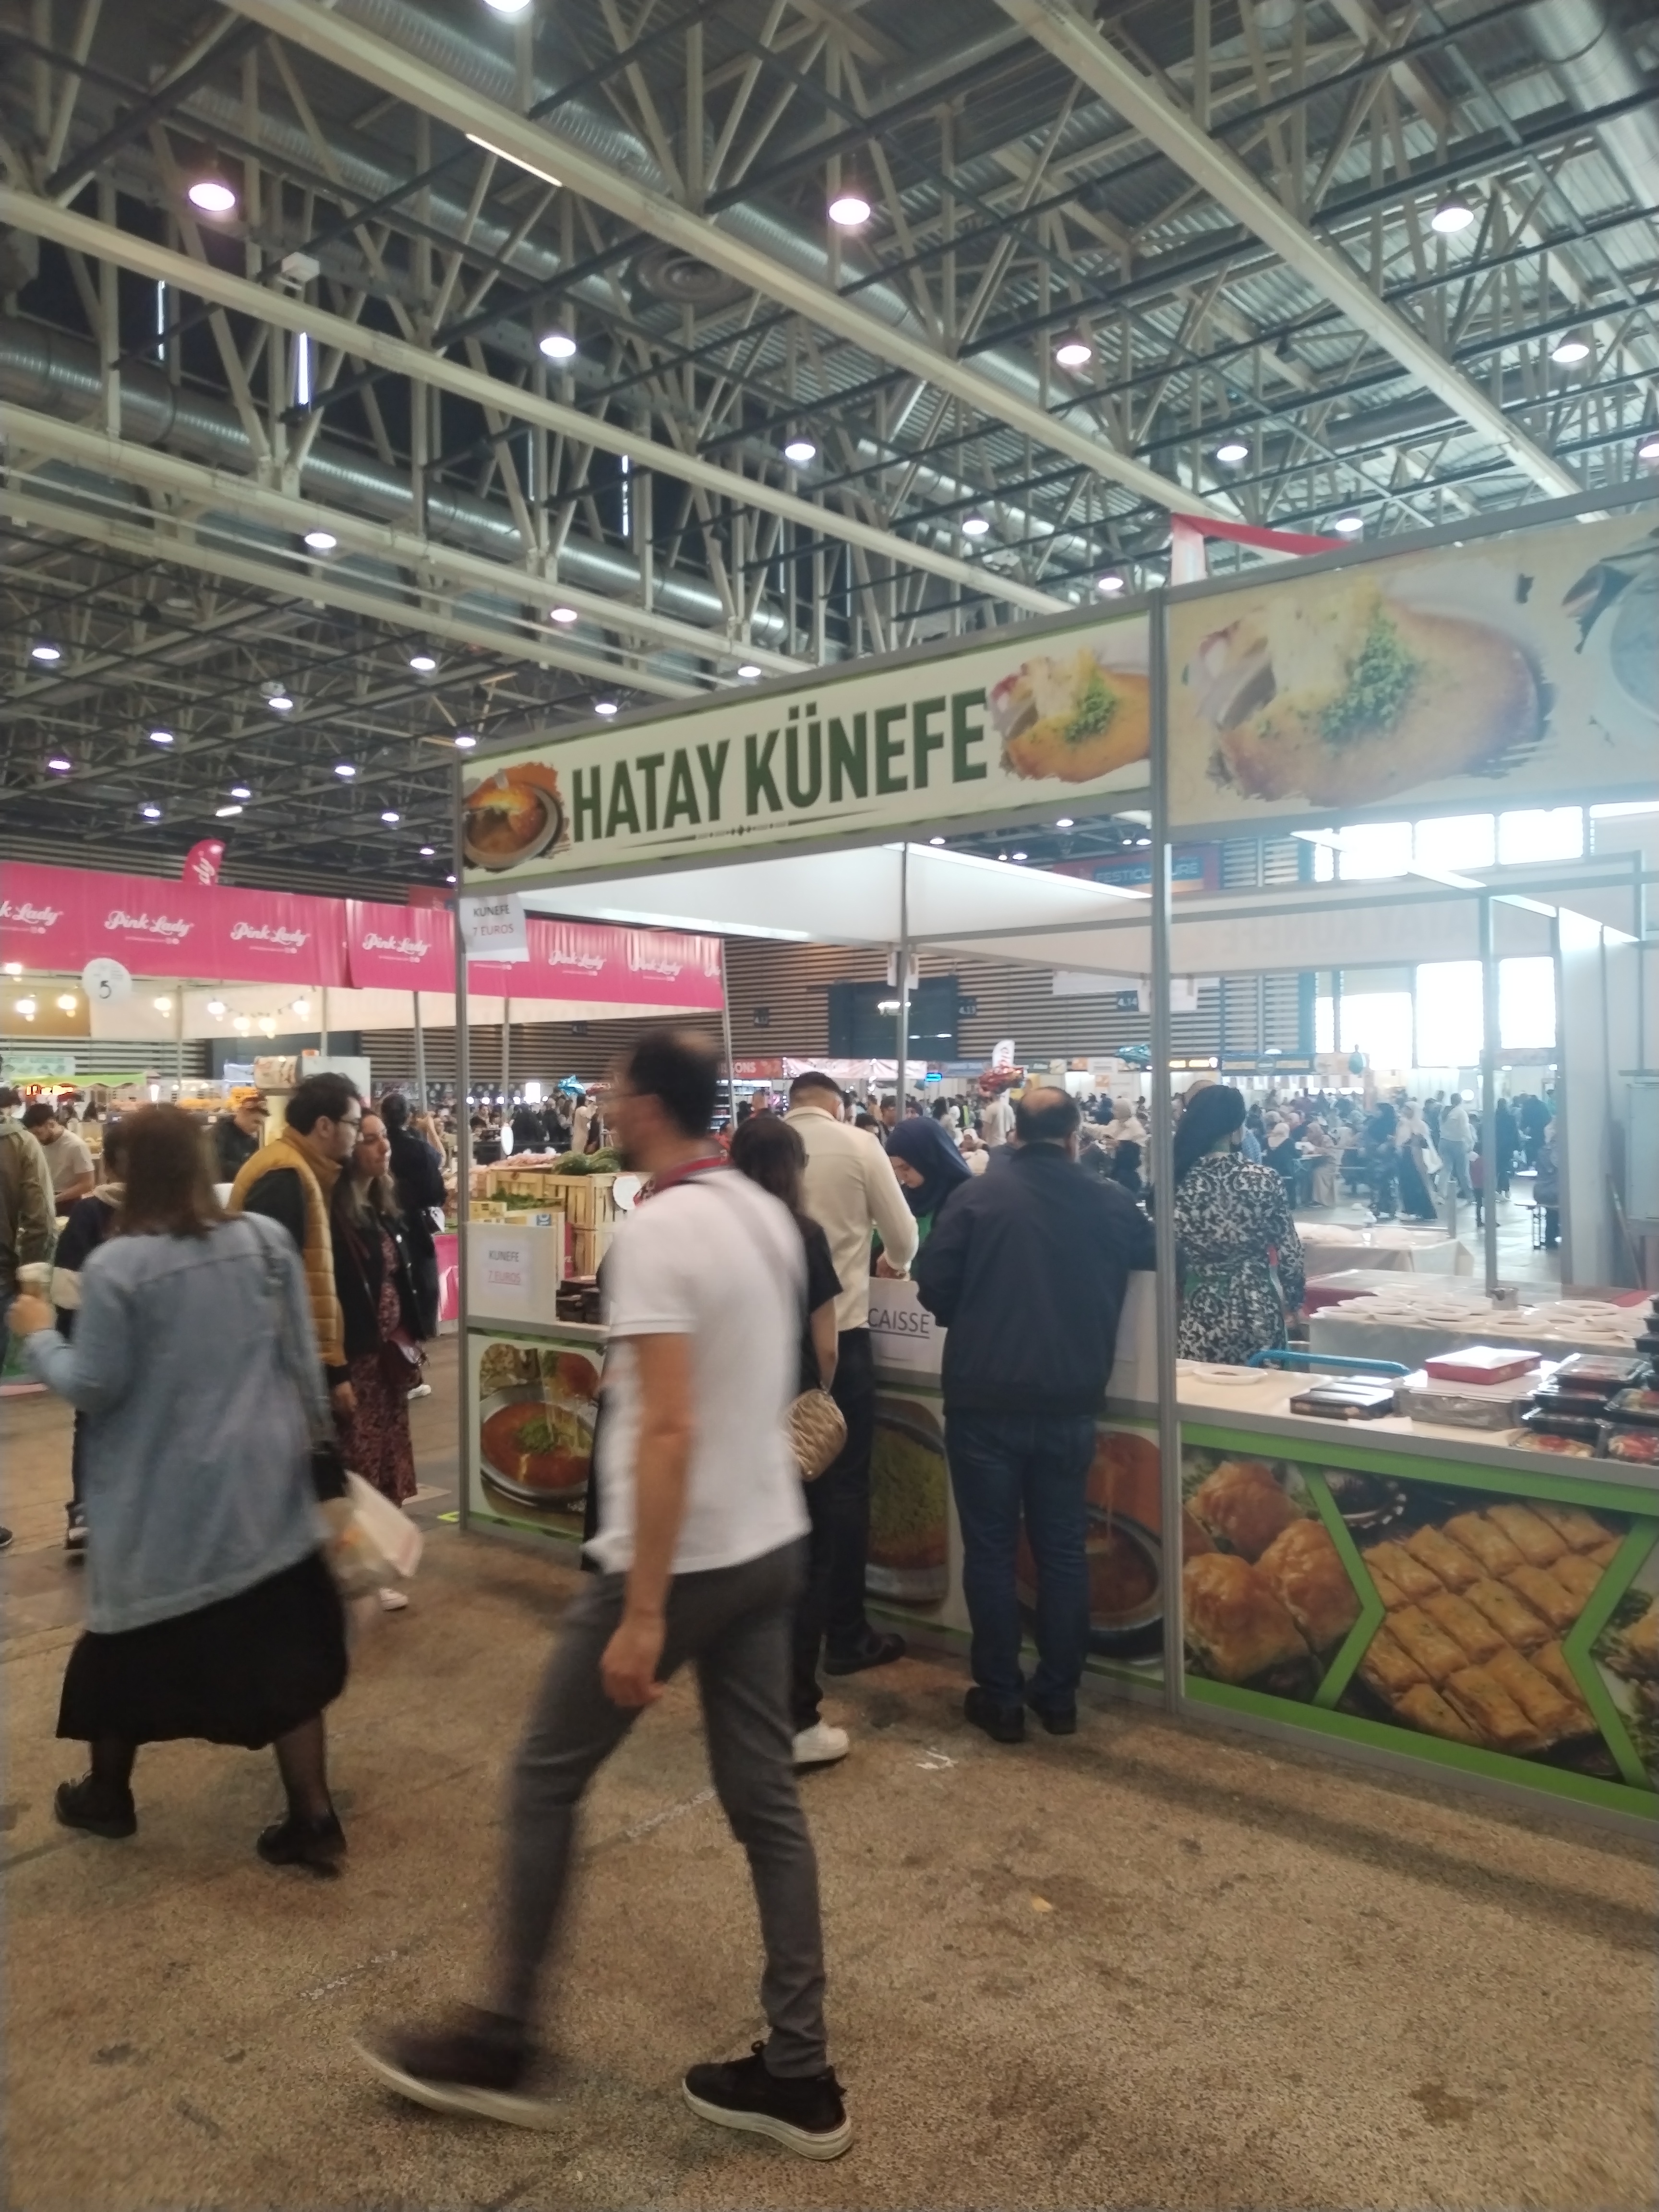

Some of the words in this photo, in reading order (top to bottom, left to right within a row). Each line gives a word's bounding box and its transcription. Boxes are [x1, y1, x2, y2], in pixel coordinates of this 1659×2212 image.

[572, 738, 731, 843] HATAY
[745, 686, 988, 817] KÜNEFE
[473, 904, 510, 918] KUNEFE
[104, 911, 149, 930] Pink
[149, 916, 191, 937] Lady
[230, 922, 270, 940] Pink
[270, 926, 307, 947] Lady
[473, 927, 478, 936] 7
[481, 924, 514, 936] EUROS
[362, 933, 397, 950] Pink
[396, 938, 428, 956] Lady
[99, 980, 112, 999] 5
[867, 1308, 930, 1334] CAISSE
